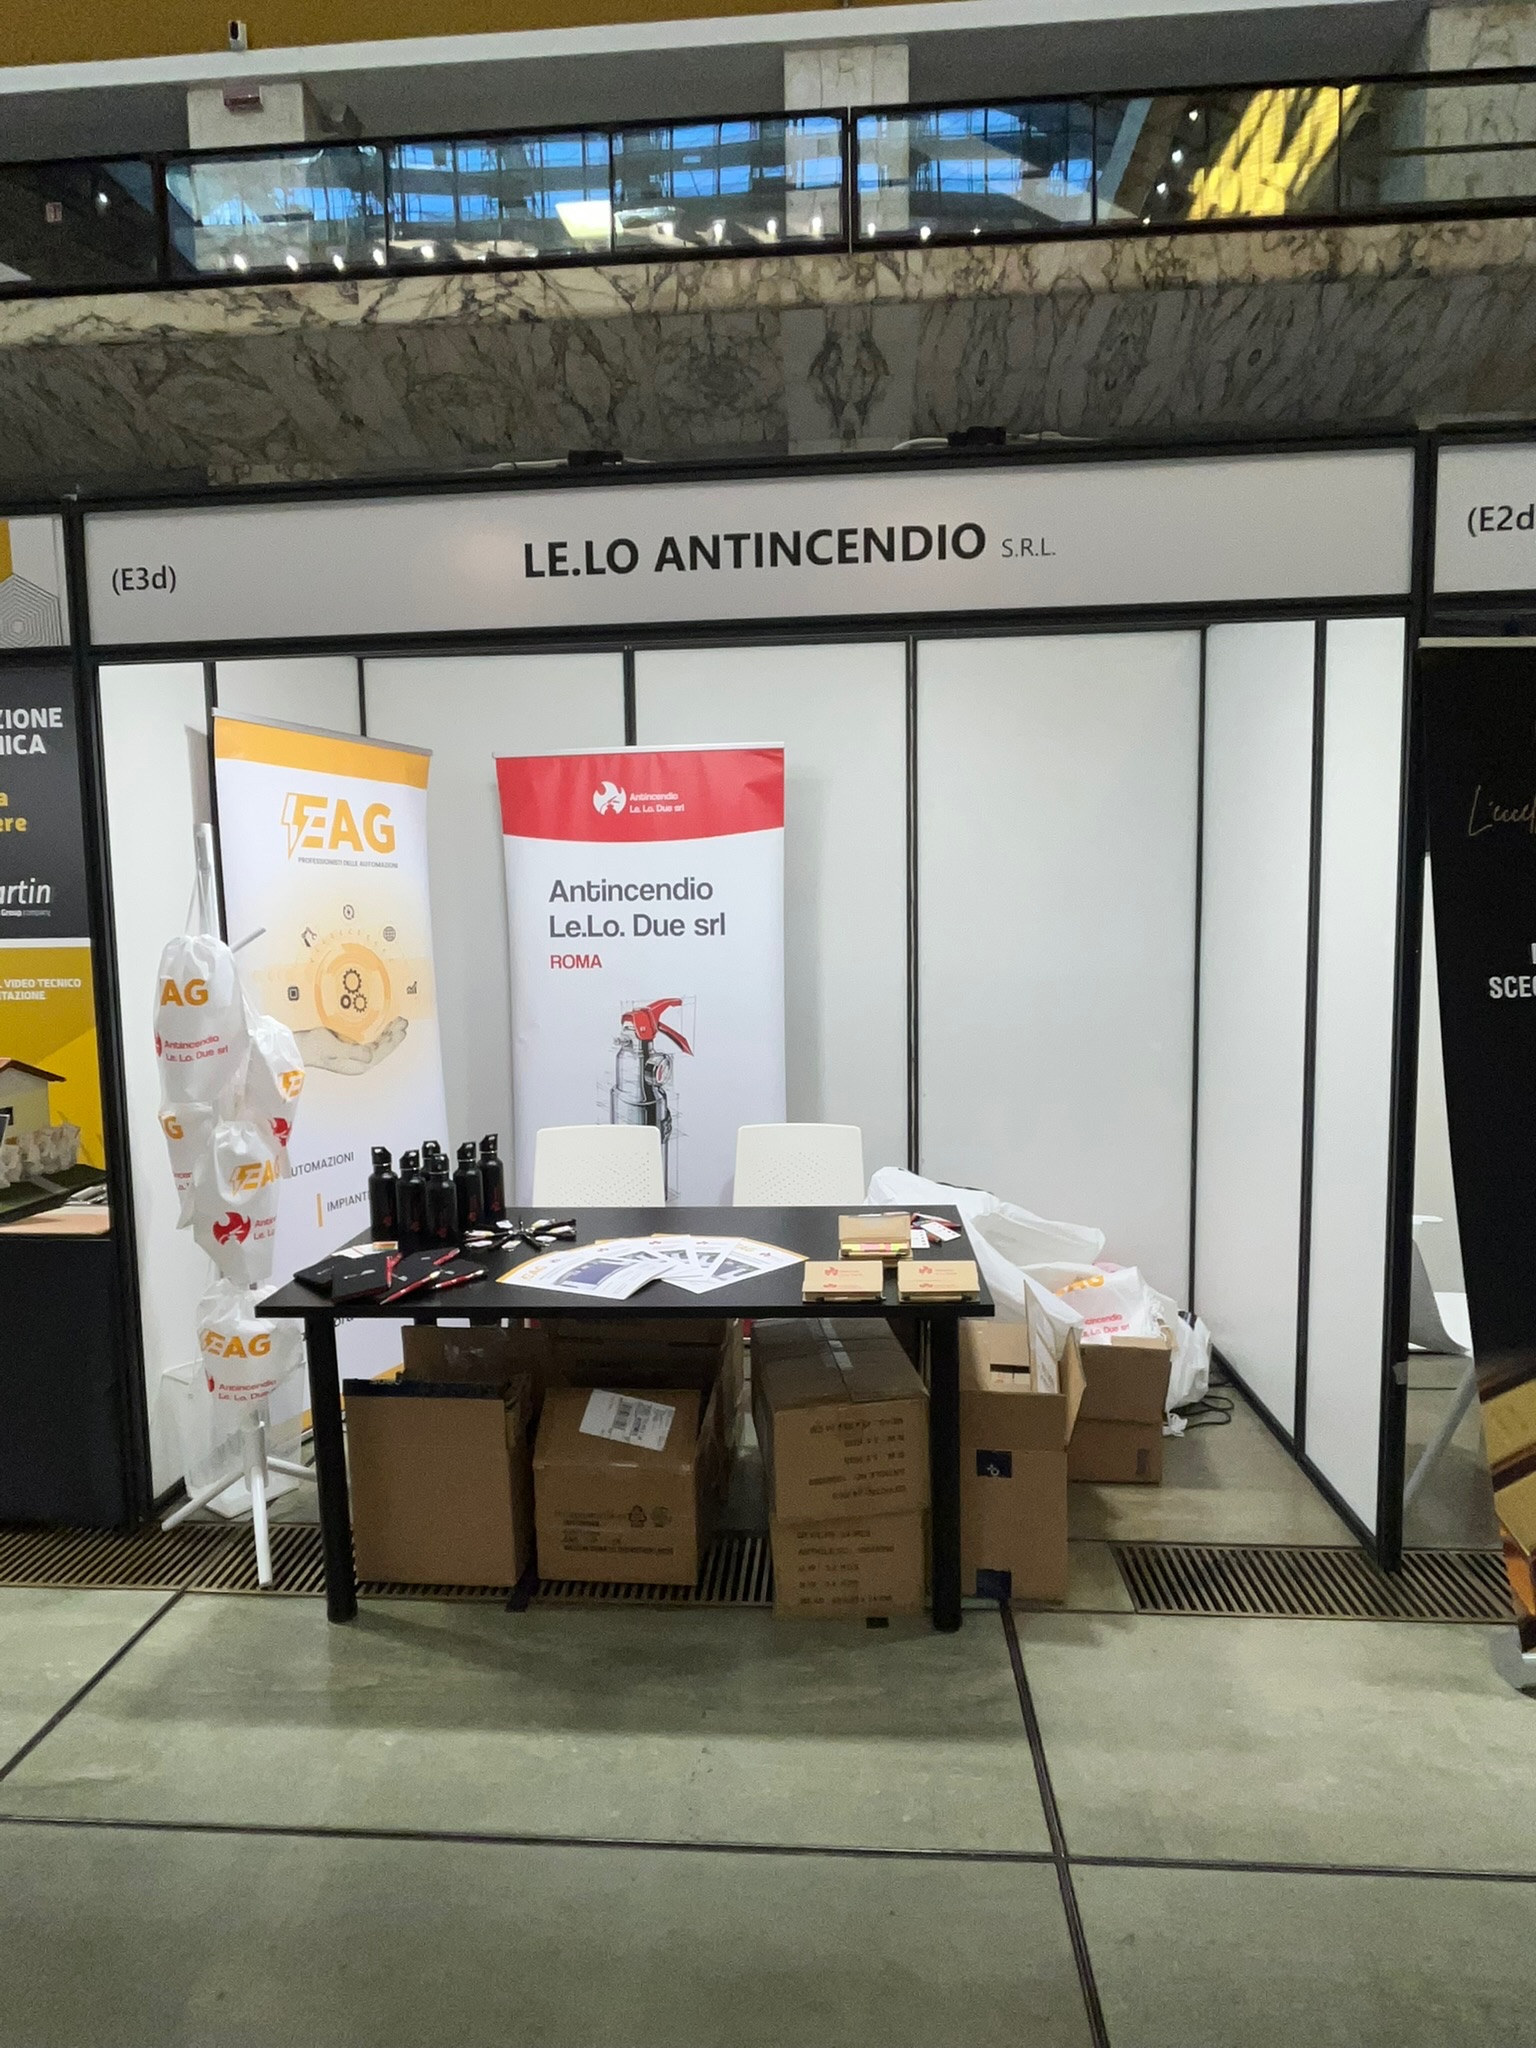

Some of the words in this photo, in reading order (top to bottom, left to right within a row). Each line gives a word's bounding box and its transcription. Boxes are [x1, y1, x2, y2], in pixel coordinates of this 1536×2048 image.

[1467, 503, 1535, 538] (E2d
[524, 537, 639, 578] LE.LO
[653, 521, 987, 572] ANTINCENDIO
[1001, 536, 1056, 558] S.R.L.
[112, 564, 177, 597] (E3d)
[0, 706, 64, 730] IONE
[0, 733, 47, 755] ICA
[655, 803, 673, 813] Due
[281, 791, 396, 860] EAG
[549, 876, 714, 903] Antincendio
[550, 914, 625, 938] Le.Lo.
[633, 913, 686, 937] Due
[693, 911, 726, 936] srl
[550, 954, 603, 969] ROMA
[4, 978, 36, 988] VIDEO
[36, 978, 82, 988] TECNICO
[195, 1049, 214, 1060] Due
